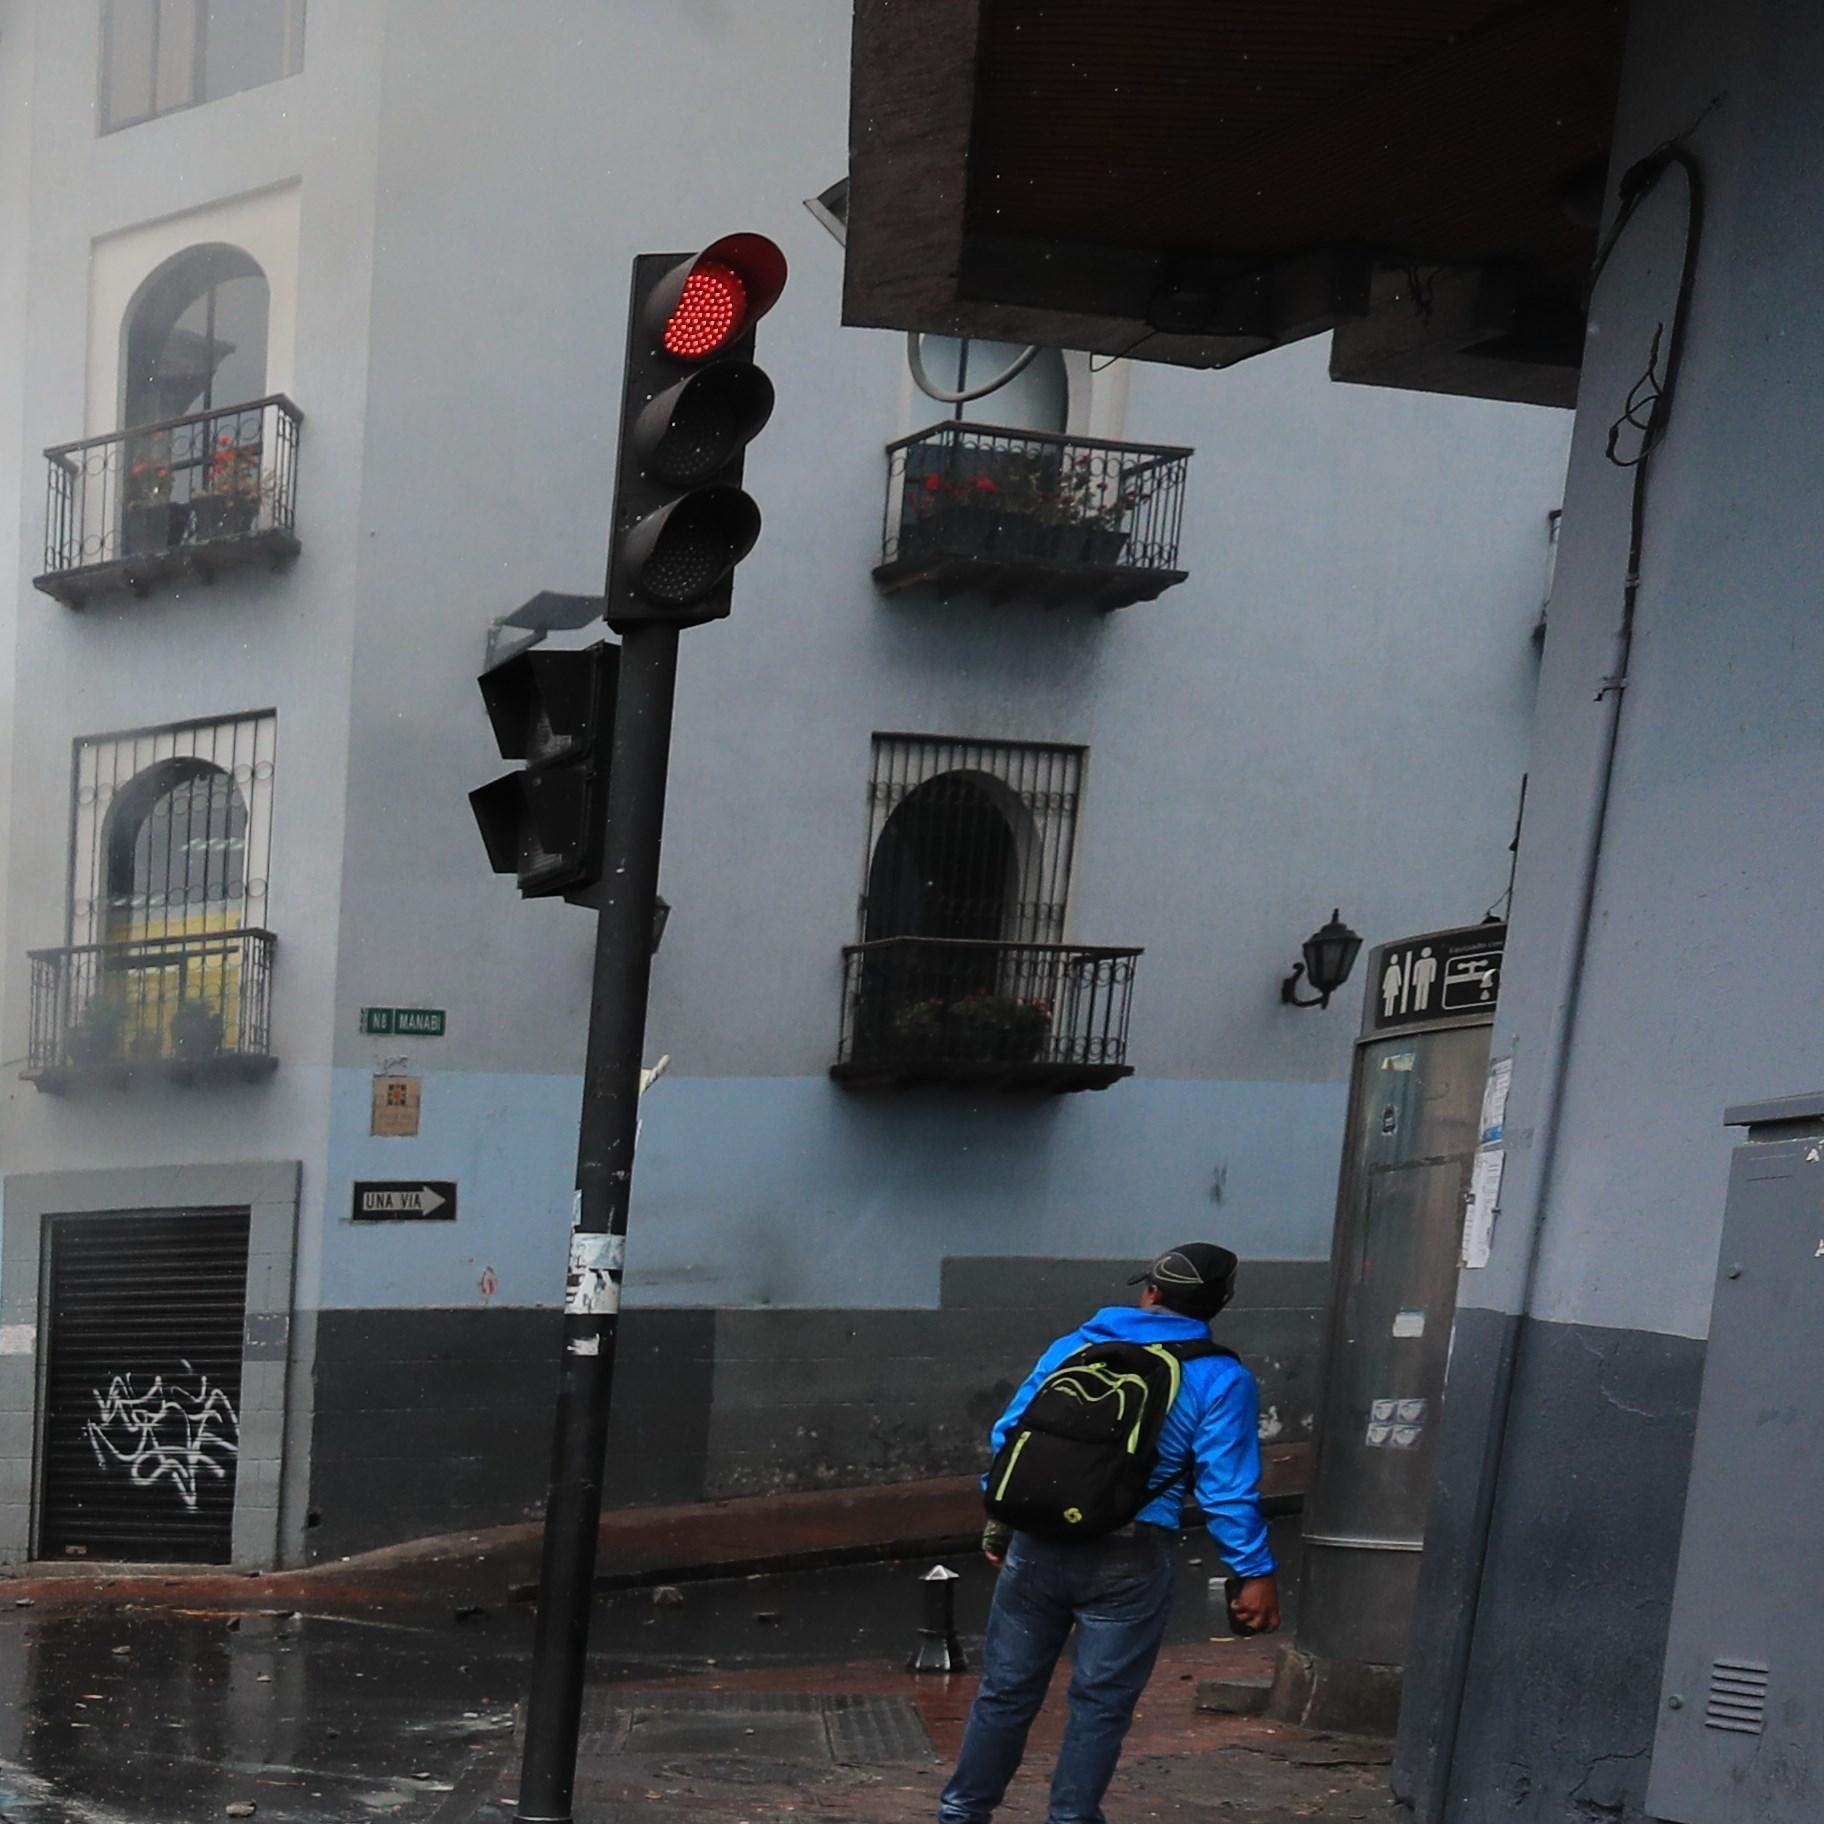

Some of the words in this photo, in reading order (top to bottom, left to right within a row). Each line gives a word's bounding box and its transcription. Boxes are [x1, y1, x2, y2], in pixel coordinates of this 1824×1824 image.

[372, 1012, 388, 1029] N8
[398, 1013, 442, 1031] MANABI
[365, 1193, 394, 1209] UNA
[400, 1193, 423, 1209] VIA
